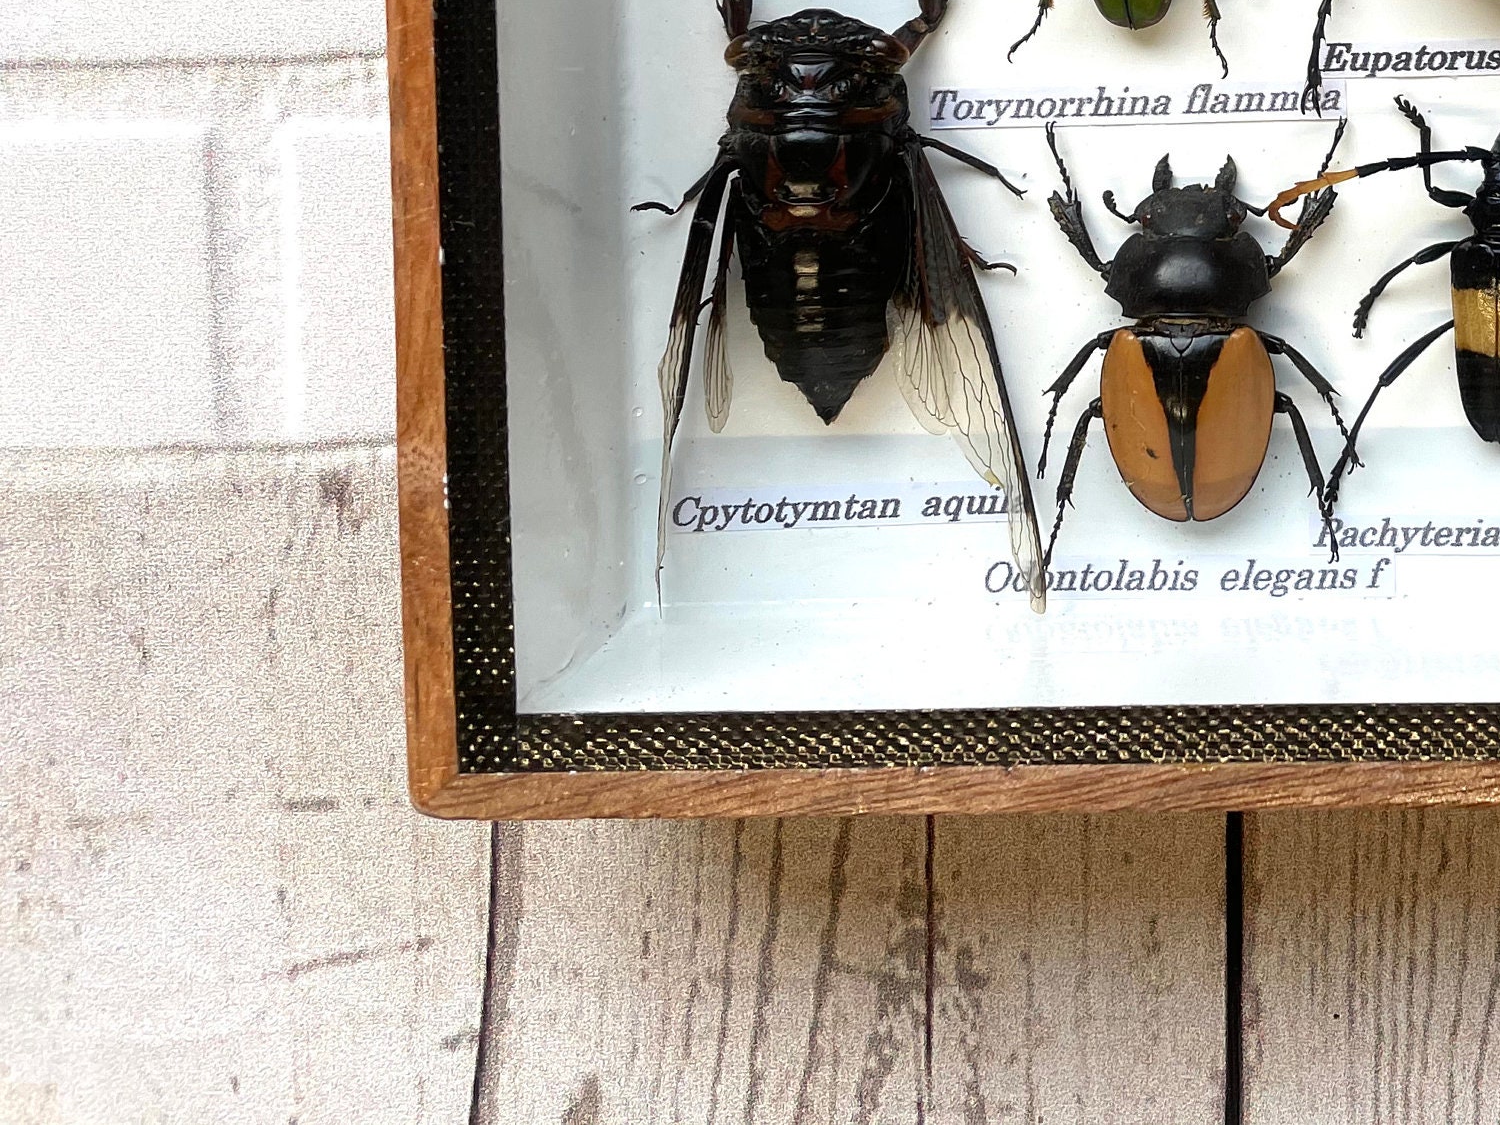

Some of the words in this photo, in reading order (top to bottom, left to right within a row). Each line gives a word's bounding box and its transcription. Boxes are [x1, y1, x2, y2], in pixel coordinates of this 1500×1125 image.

[930, 86, 1170, 125] Torynorrhina
[673, 494, 900, 532] Cpytotymtan
[1312, 517, 1500, 553] Pachyteria
[1220, 558, 1357, 597] elegans
[1366, 557, 1390, 589] f
